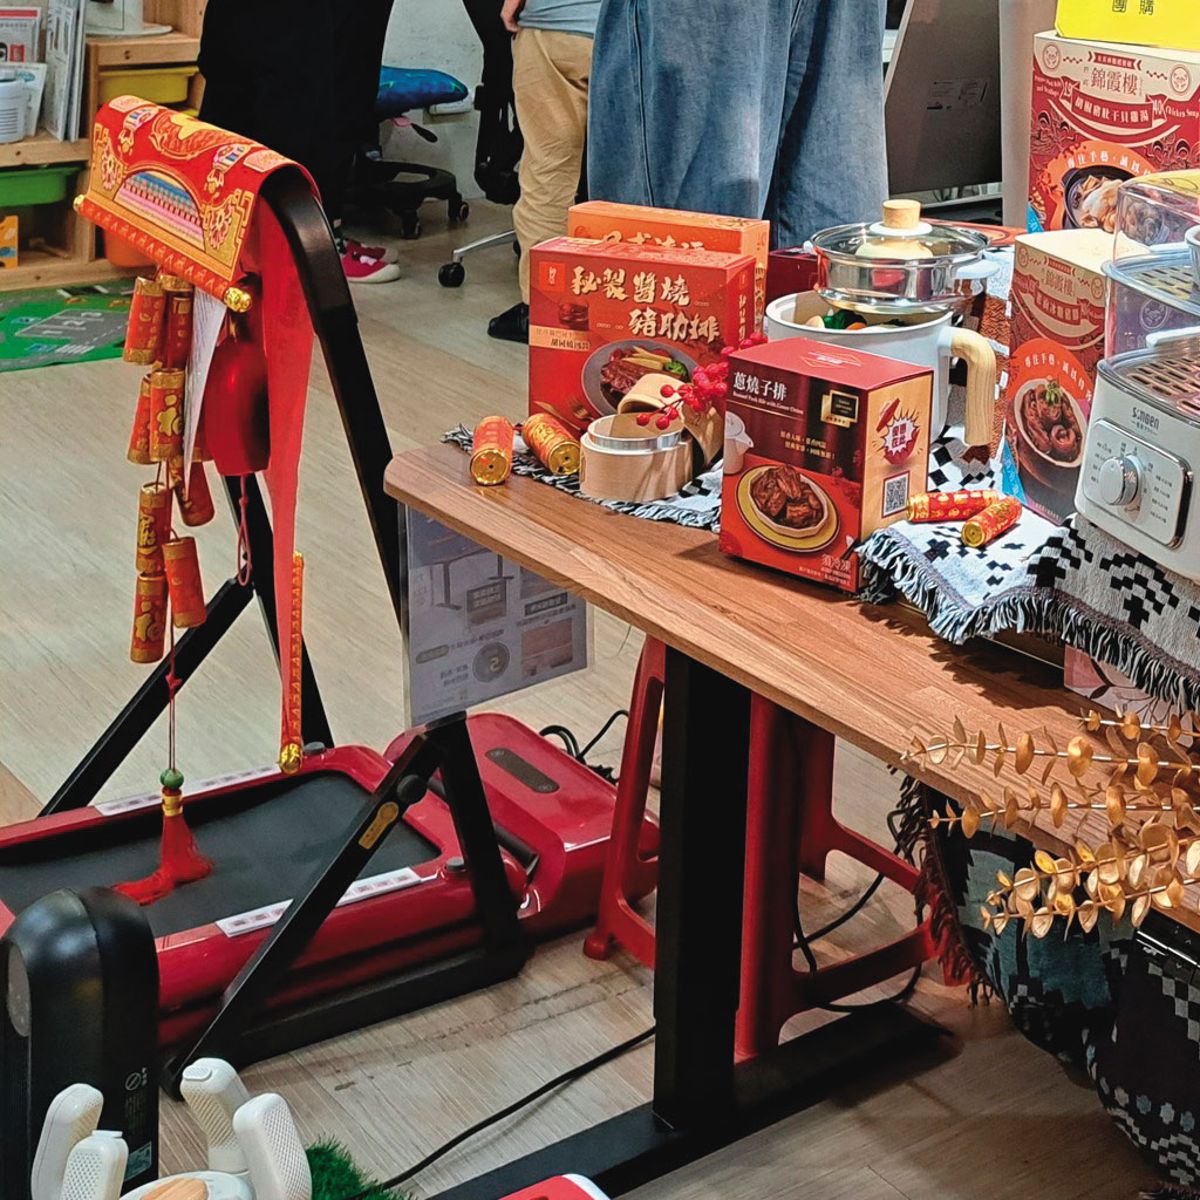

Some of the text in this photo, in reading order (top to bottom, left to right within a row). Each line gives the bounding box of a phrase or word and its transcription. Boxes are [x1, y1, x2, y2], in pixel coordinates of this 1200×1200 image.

[1091, 66, 1139, 97] 錦霞樓
[571, 264, 691, 308] 秘製醬燒
[628, 307, 721, 344] 豬肋排
